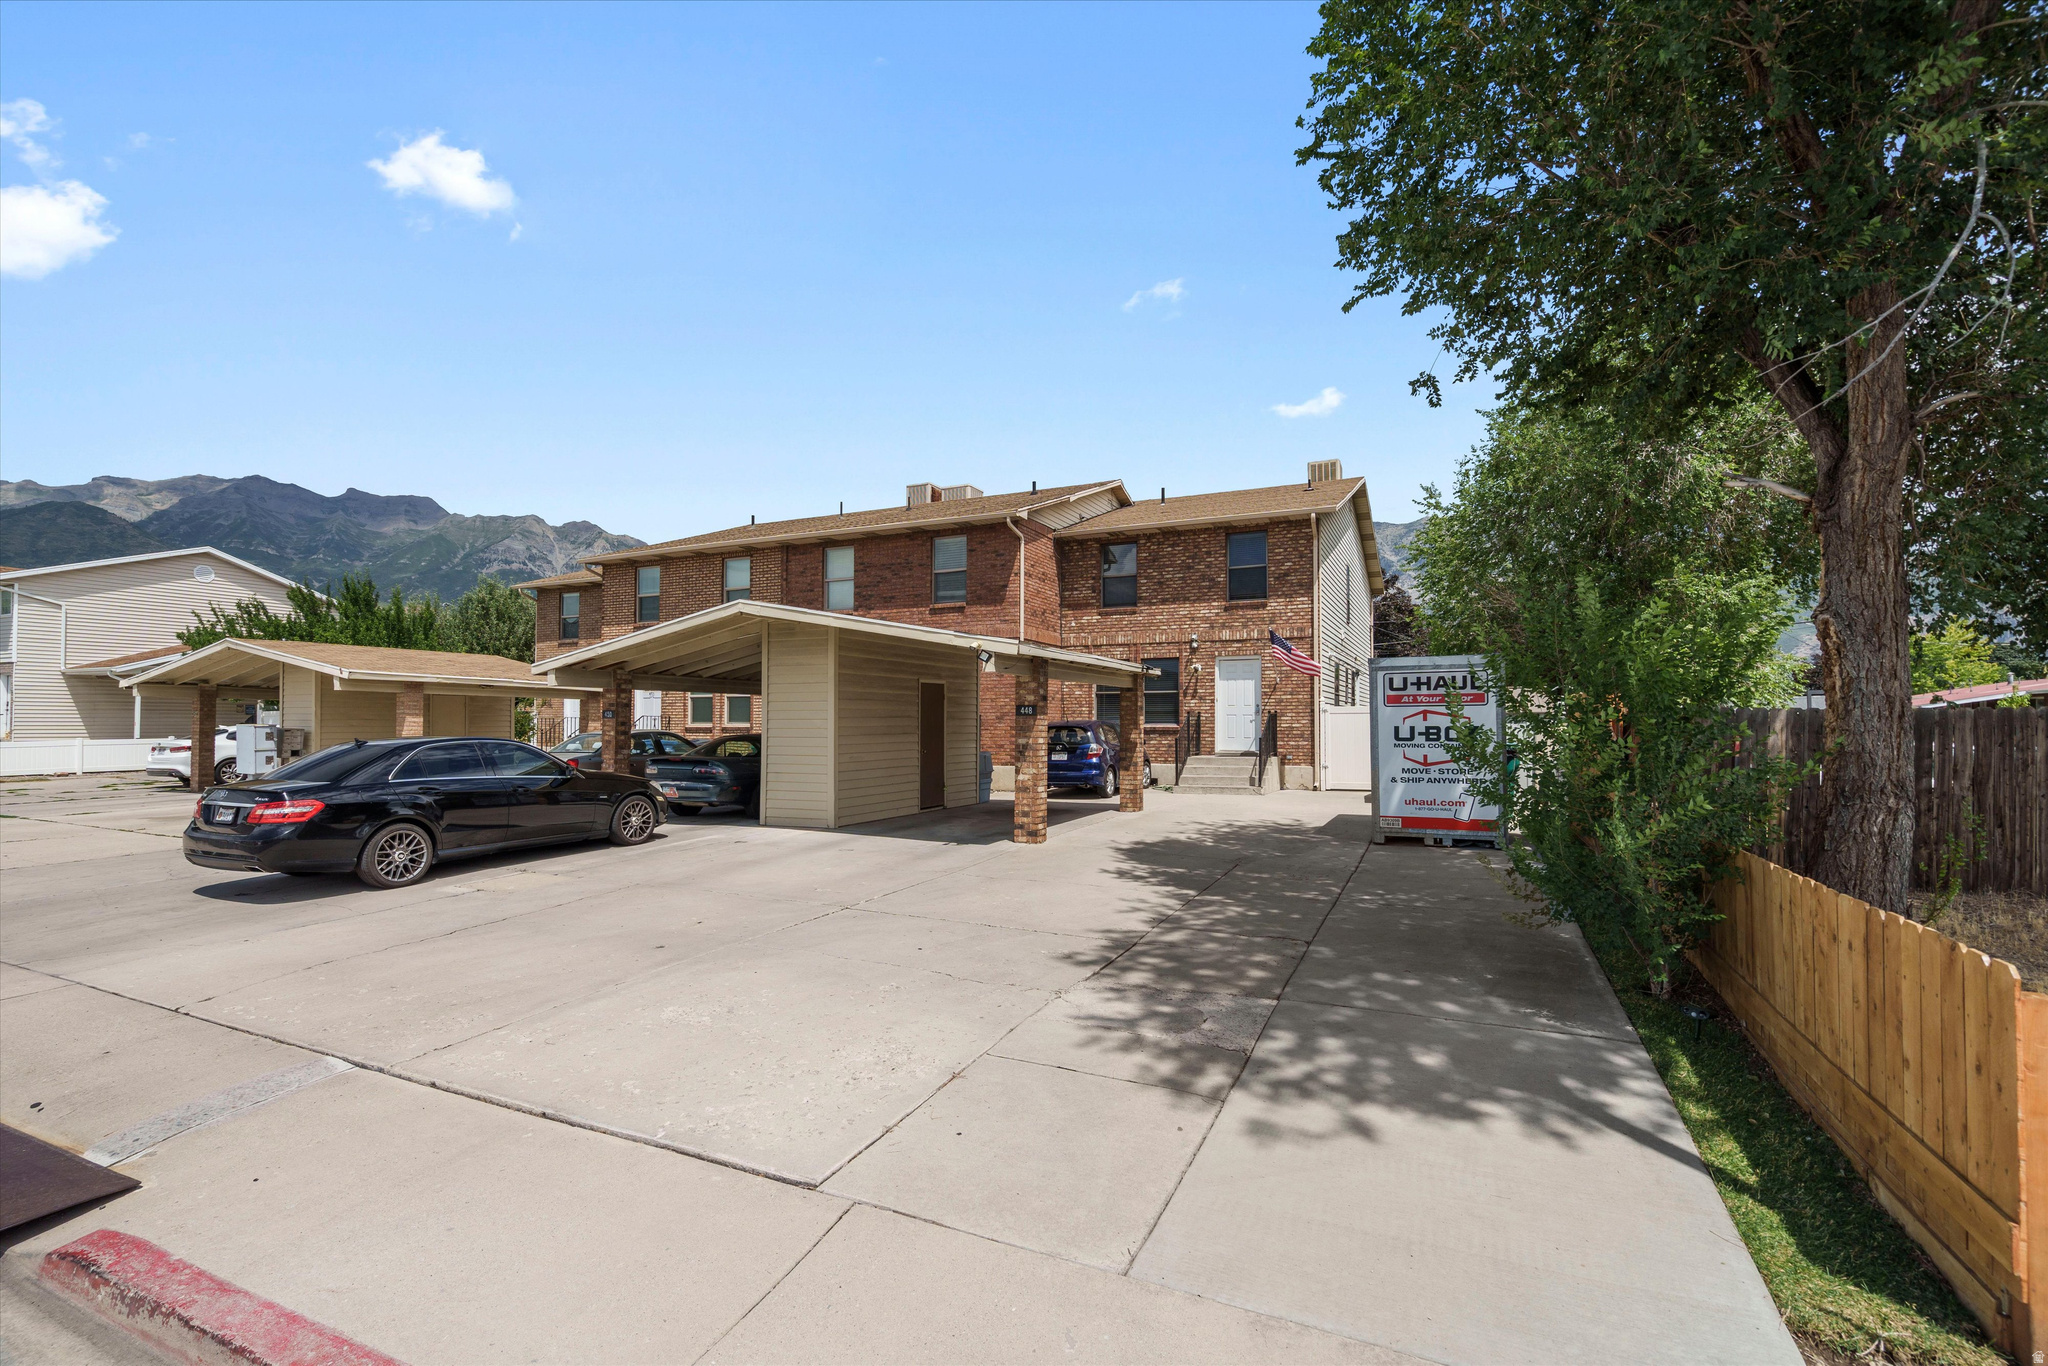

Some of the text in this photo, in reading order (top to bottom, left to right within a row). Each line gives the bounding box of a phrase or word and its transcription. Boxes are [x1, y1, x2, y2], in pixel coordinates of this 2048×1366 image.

[1020, 706, 1033, 715] 448
[1390, 776, 1398, 784] &
[1404, 798, 1466, 807] uhaul.com
